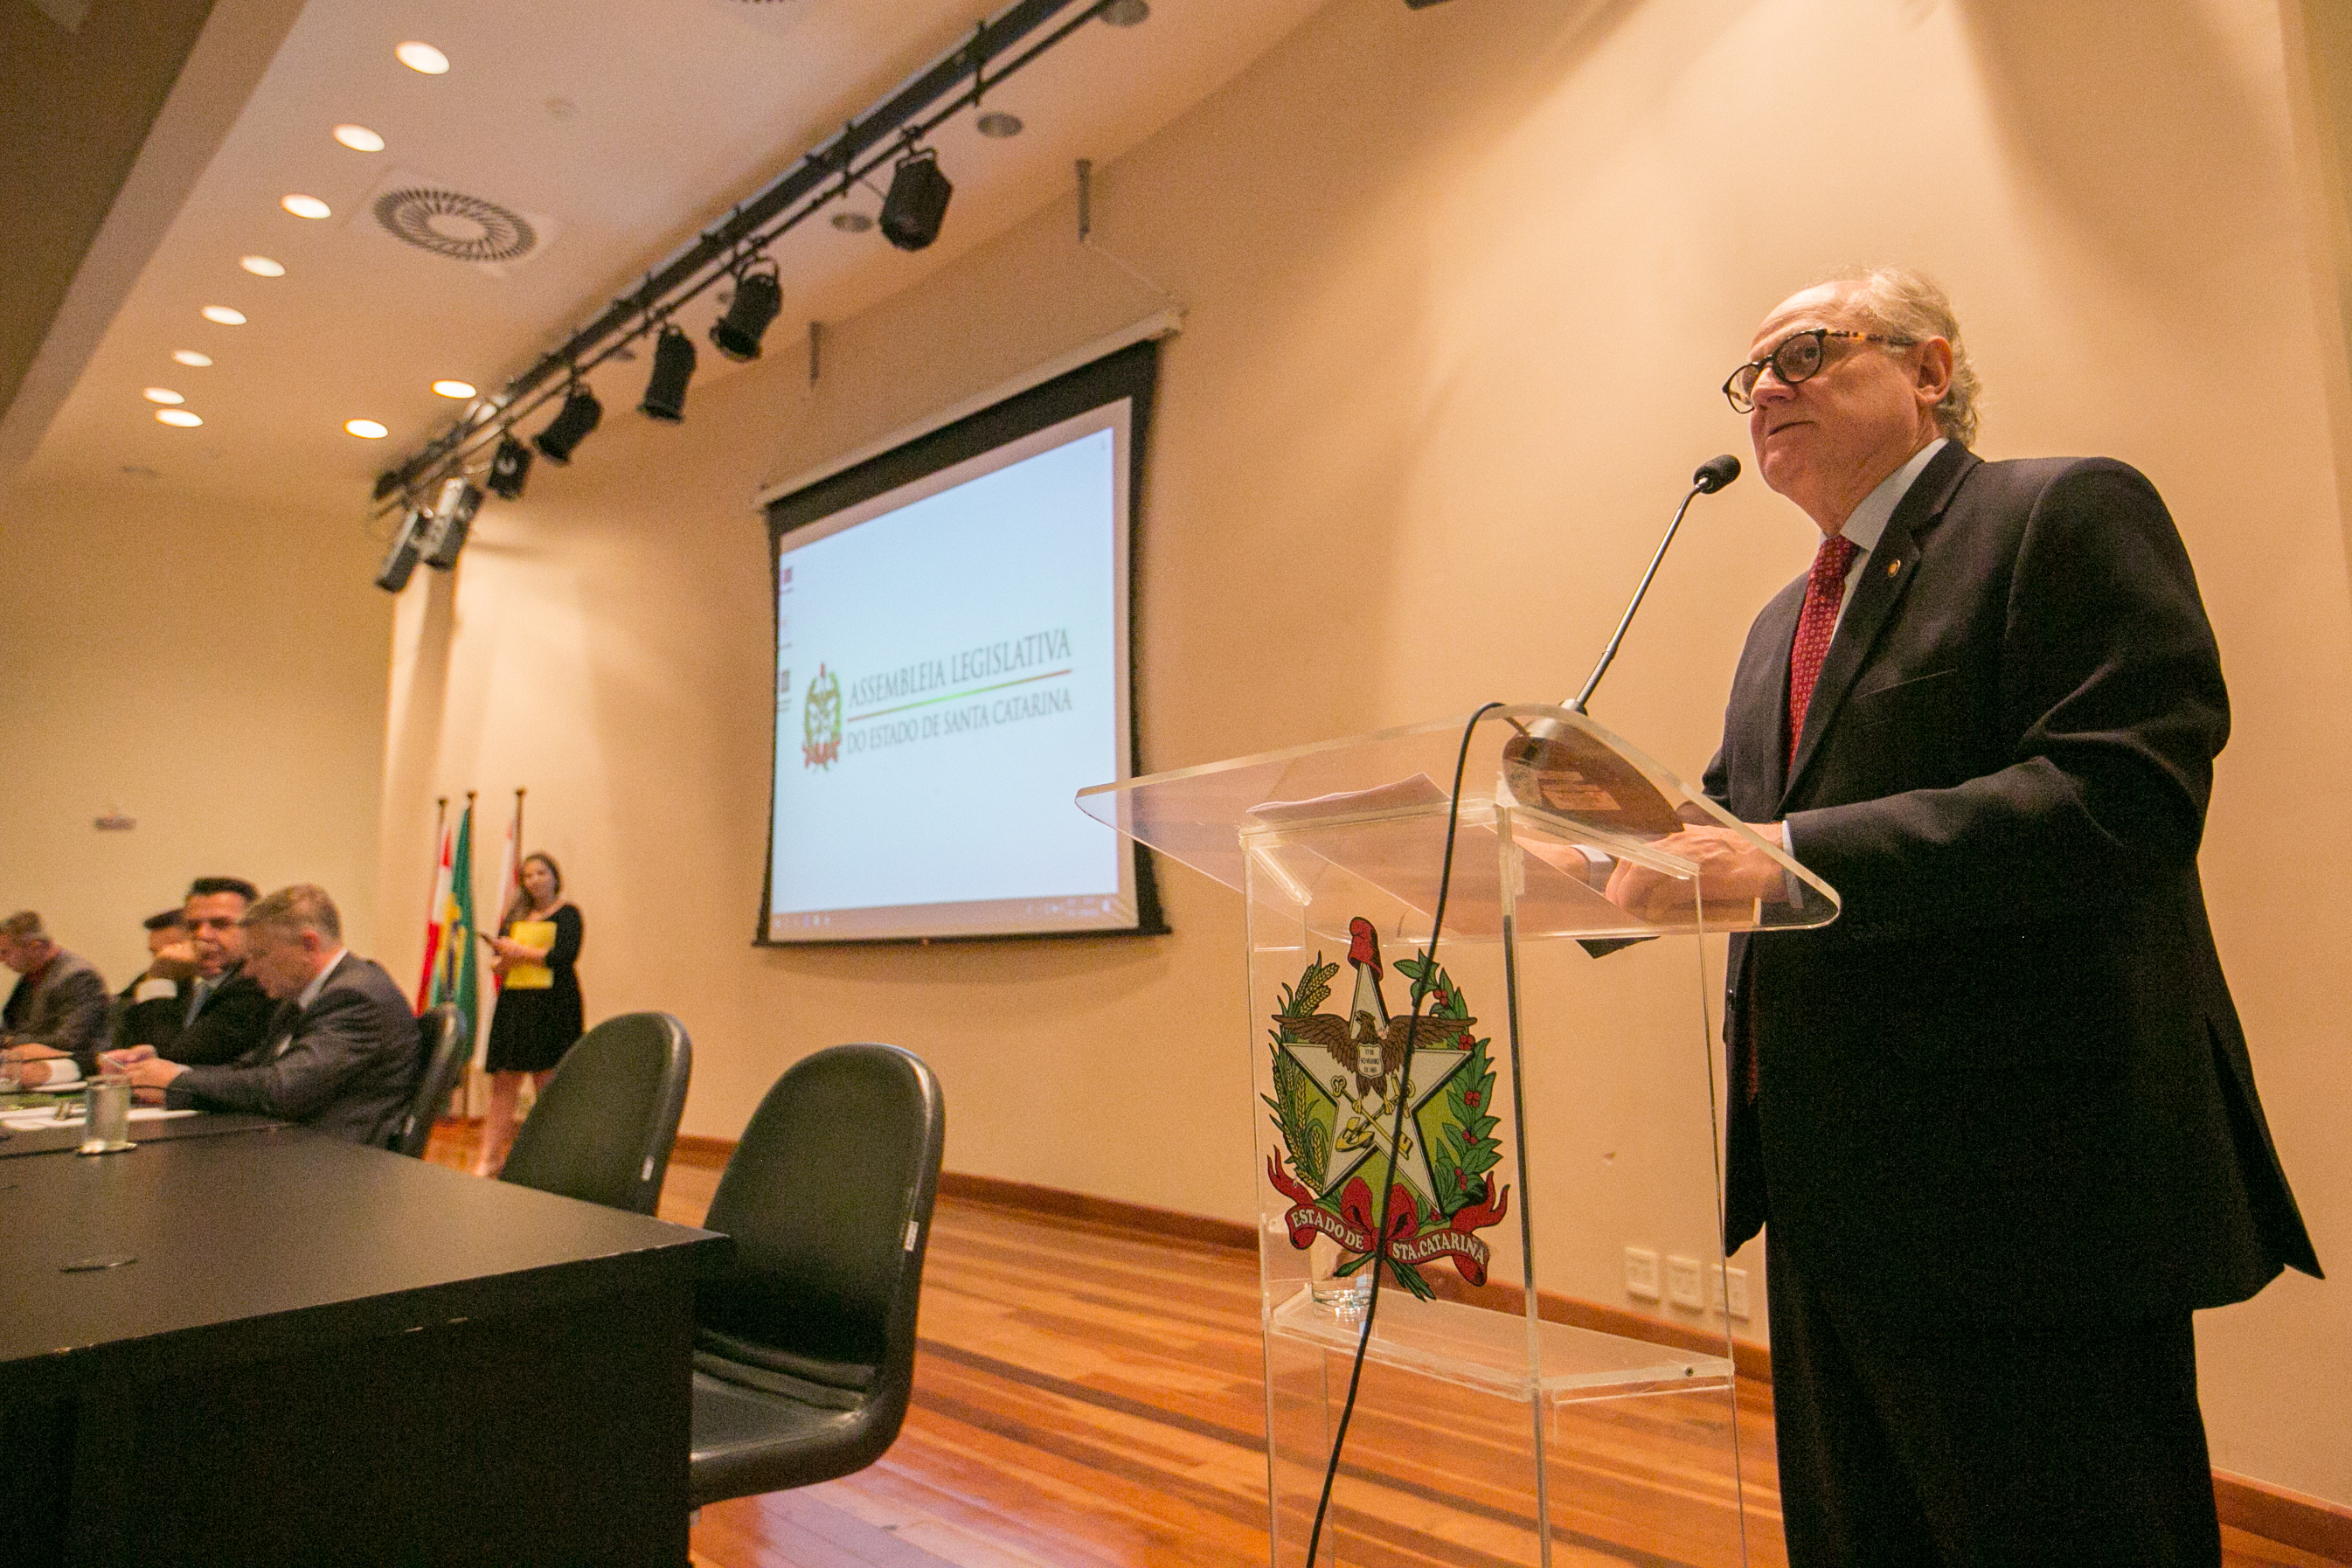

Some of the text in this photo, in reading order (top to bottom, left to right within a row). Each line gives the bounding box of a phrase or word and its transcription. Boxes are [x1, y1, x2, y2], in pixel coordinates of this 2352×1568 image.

[849, 628, 1072, 709] ASSEMBLEIA LEGISLATIVA
[846, 686, 1072, 755] DO ESTADO DE SANTA CATARINA
[1290, 1210, 1344, 1238] ESTADO
[1344, 1232, 1364, 1250] DE
